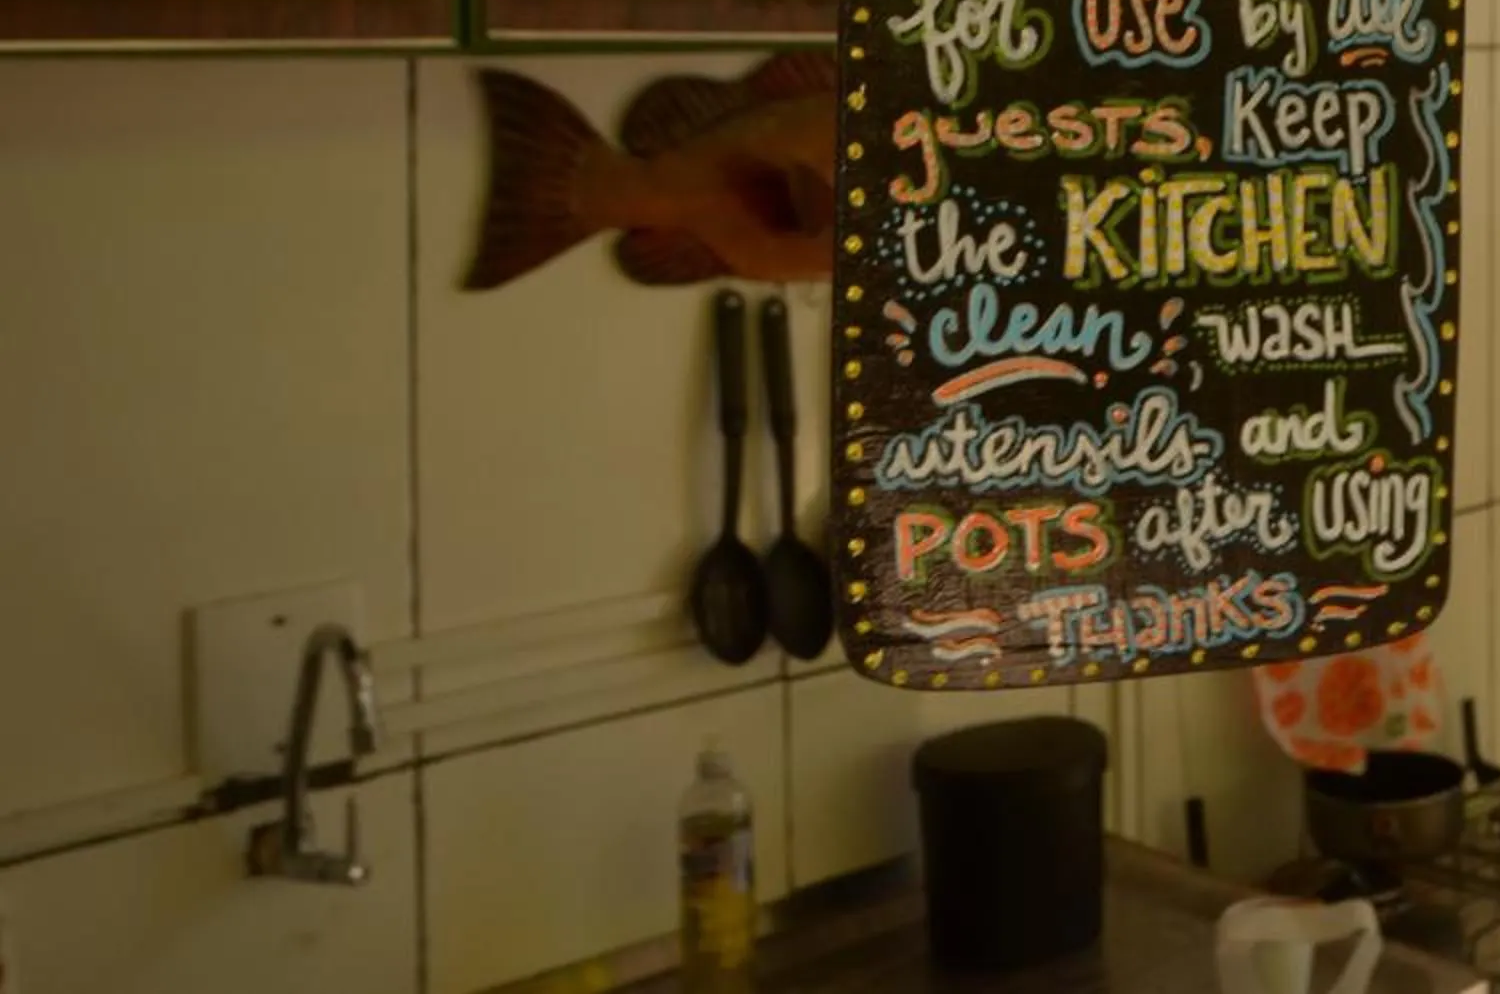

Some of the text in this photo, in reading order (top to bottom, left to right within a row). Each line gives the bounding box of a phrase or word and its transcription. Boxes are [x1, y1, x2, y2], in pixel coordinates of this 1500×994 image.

[1228, 74, 1388, 176] Keep
[898, 198, 1030, 285] the
[883, 379, 1366, 486] utensils and
[894, 453, 1431, 580] POTS after using
